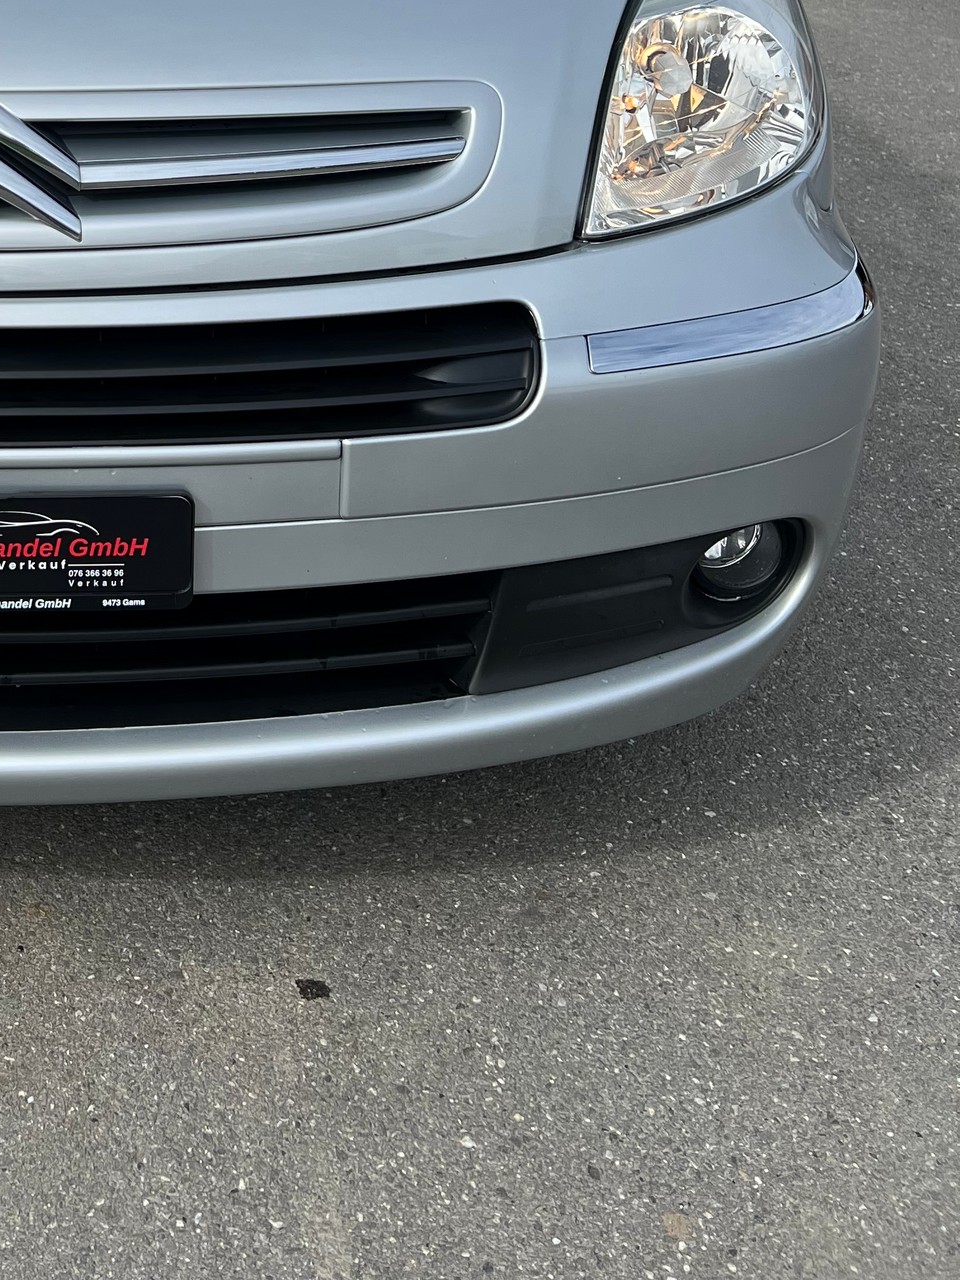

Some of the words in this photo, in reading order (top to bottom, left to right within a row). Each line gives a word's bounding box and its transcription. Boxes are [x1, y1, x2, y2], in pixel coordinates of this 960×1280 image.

[69, 538, 149, 557] GmbH
[68, 579, 124, 588] Verkauf
[34, 598, 72, 609] GmbH
[102, 599, 121, 607] 9473
[122, 598, 146, 606] Gams
